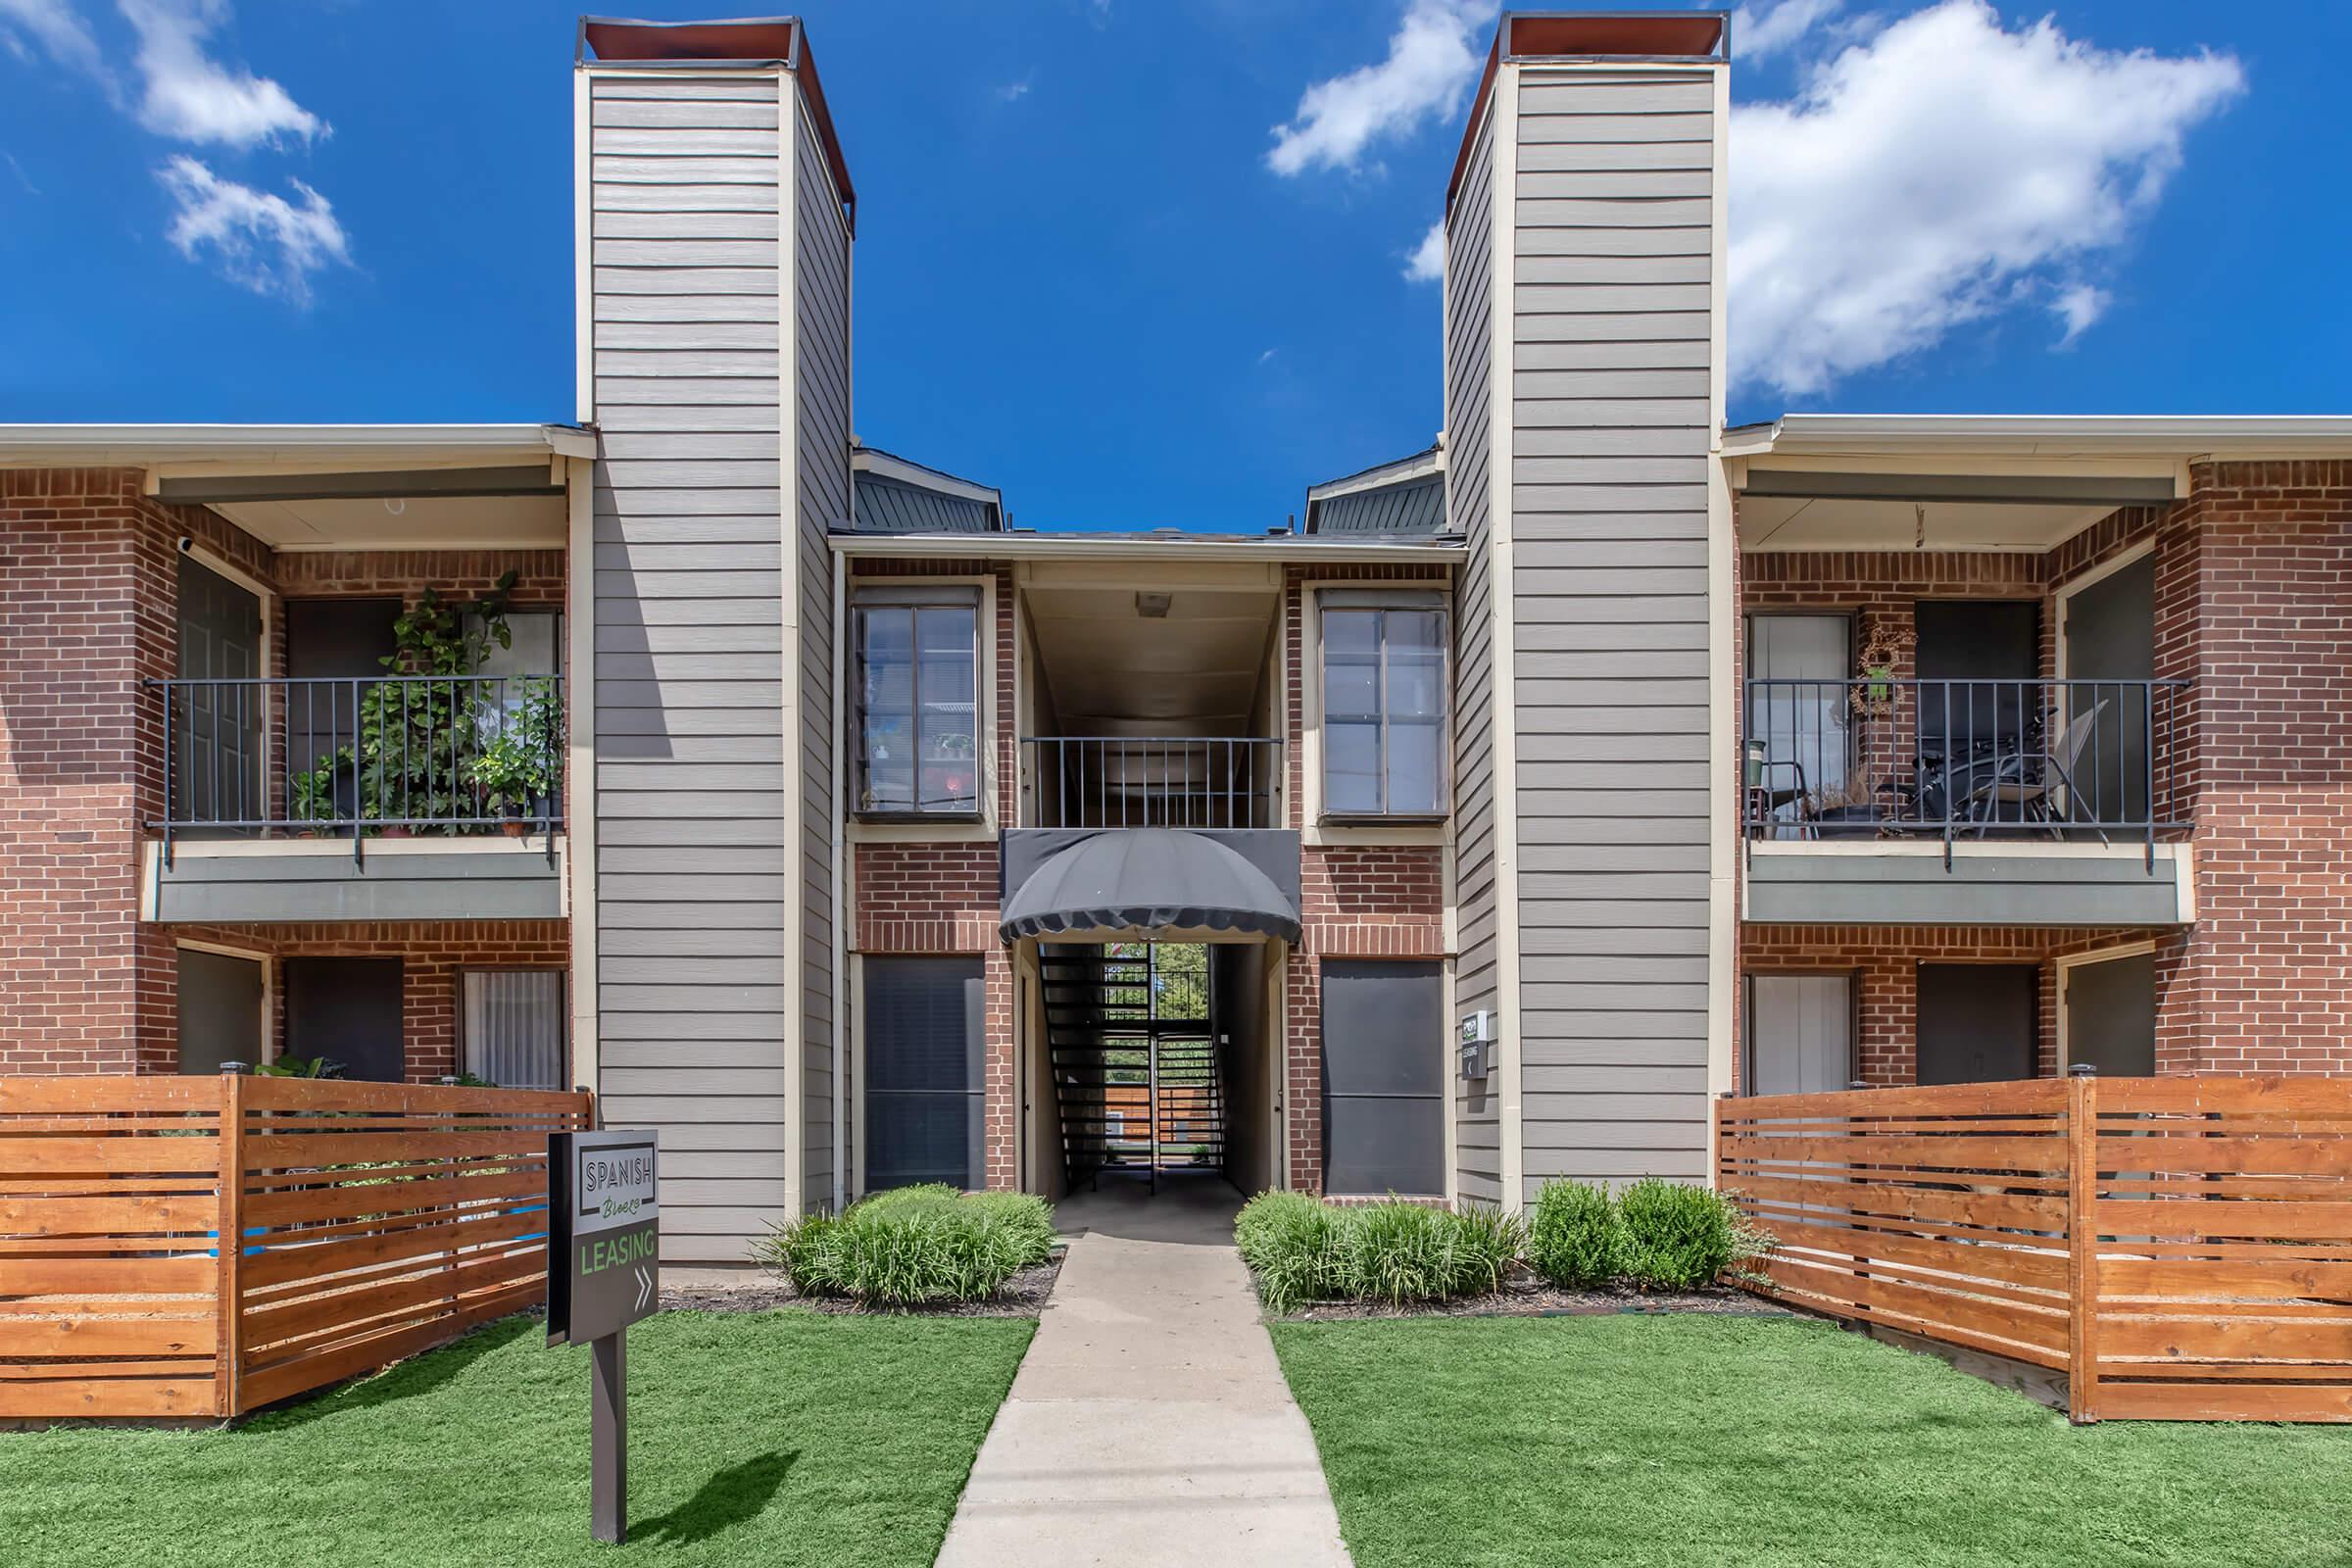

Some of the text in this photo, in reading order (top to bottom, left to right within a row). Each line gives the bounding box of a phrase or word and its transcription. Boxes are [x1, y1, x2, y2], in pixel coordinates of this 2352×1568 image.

[586, 1157, 652, 1192] SPANISH
[603, 1197, 641, 1219] Breeze
[581, 1229, 655, 1276] LEASING
